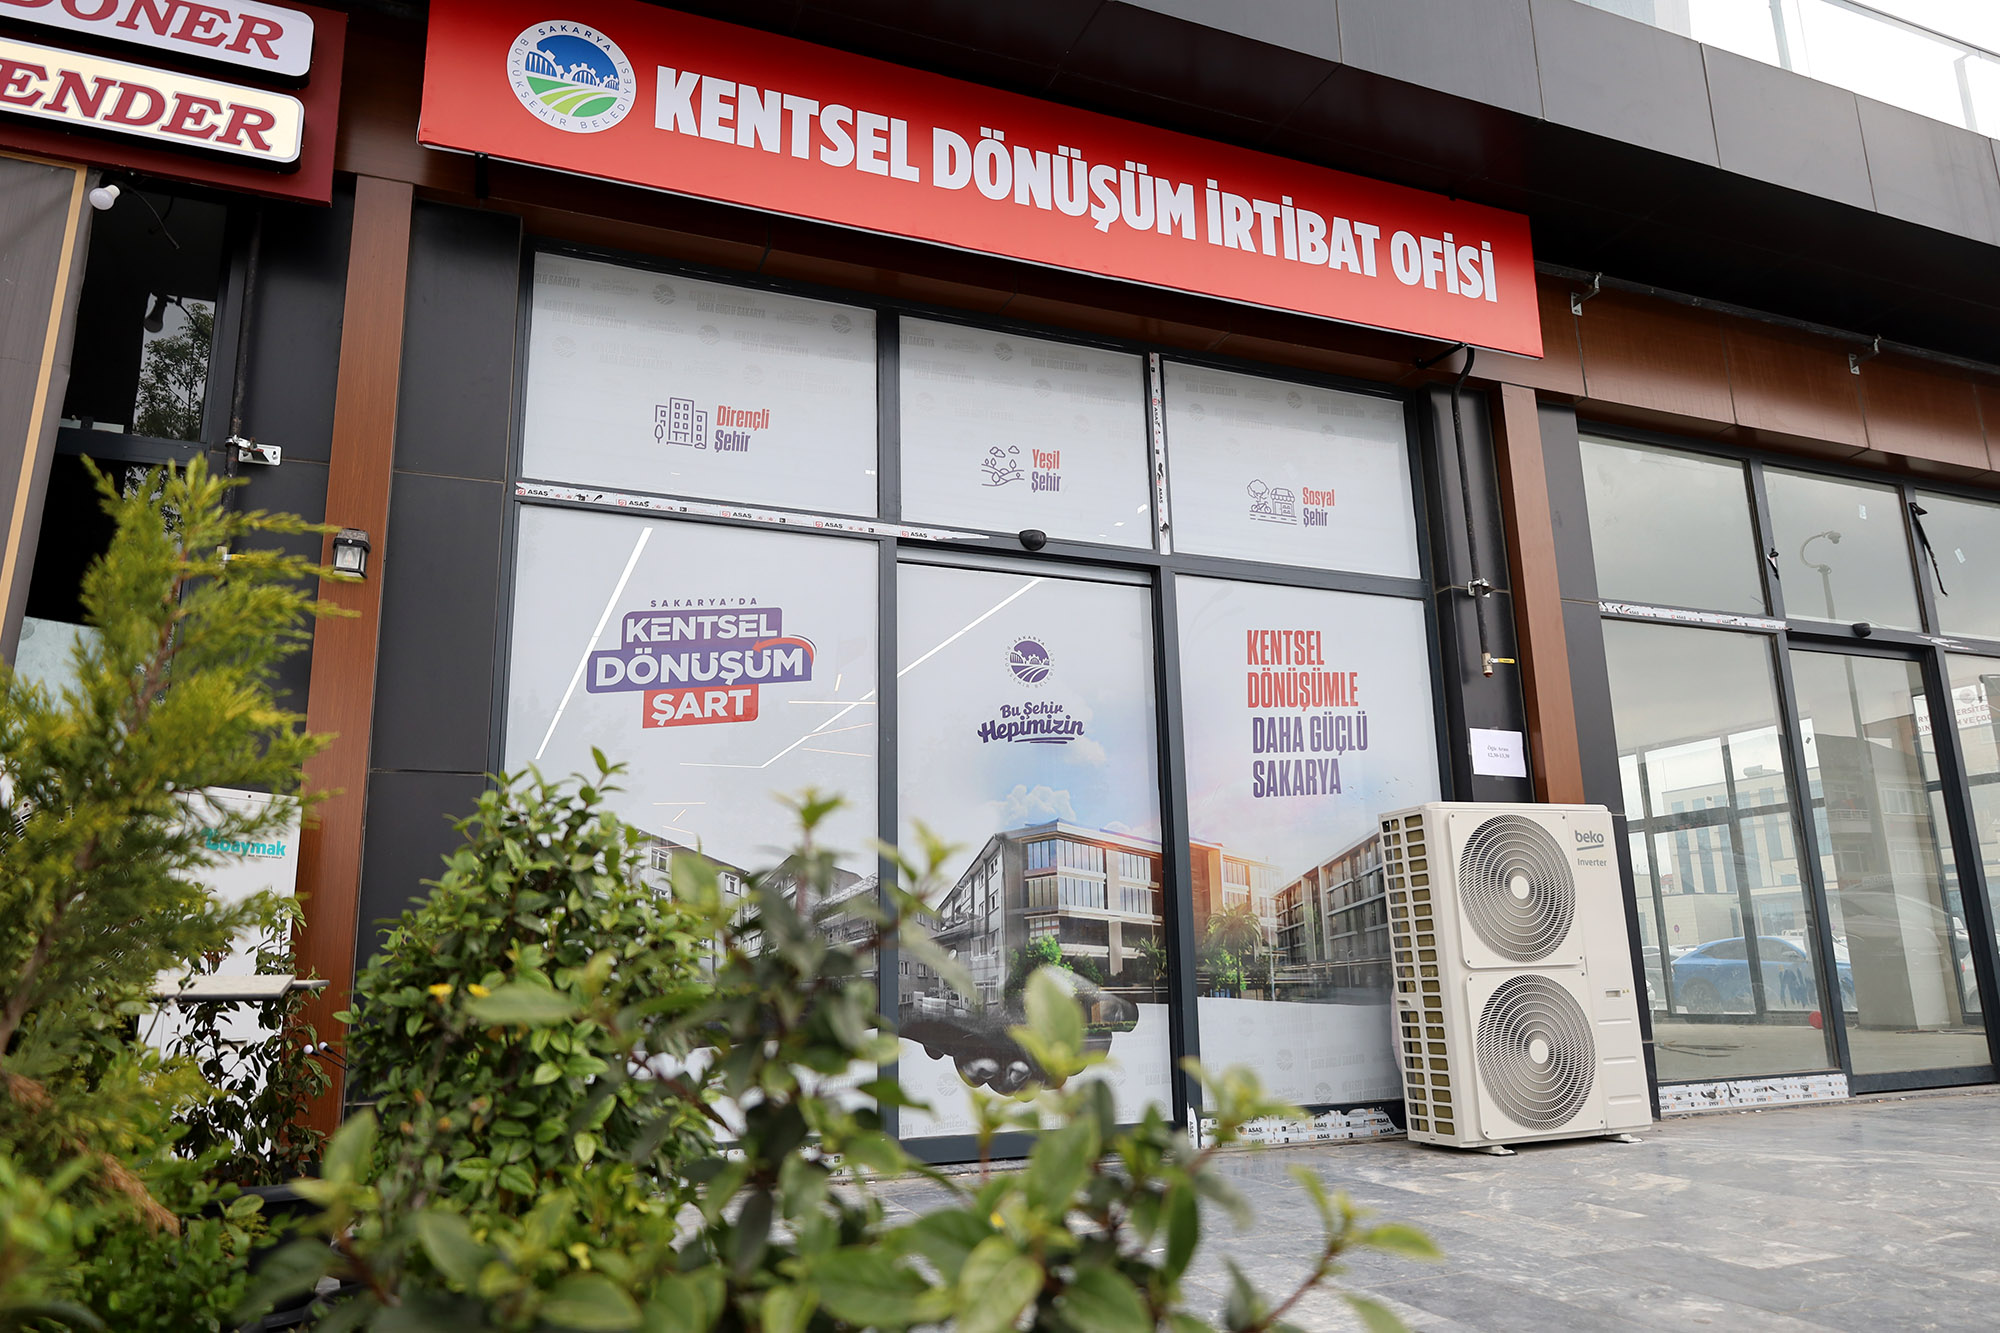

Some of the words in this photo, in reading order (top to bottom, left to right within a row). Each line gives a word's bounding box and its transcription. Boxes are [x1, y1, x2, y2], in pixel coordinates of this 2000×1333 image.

[0, 0, 284, 60] NER
[538, 24, 611, 52] SAKARYA
[654, 65, 920, 183] KENTSEL
[933, 126, 1197, 241] DÖNÜŞÜM
[1205, 178, 1381, 278] İRTİBAT
[1390, 231, 1498, 303] OFİSİ
[717, 405, 770, 431] Dirençli
[714, 430, 751, 453] Şehir
[1032, 449, 1060, 470] Yeşil
[527, 489, 549, 497] ASAS
[1031, 471, 1061, 492] Şehir
[1302, 487, 1335, 507] Sosyal
[732, 511, 752, 519] ASAS
[1303, 507, 1328, 527] Şehir
[650, 597, 758, 608] SAKARYA'DA
[626, 614, 778, 643] KENTSEL
[1247, 630, 1324, 665] KENTSEL
[1247, 667, 1358, 712] DÖNÜŞÜMLE
[651, 689, 751, 726] ŞART
[1000, 704, 1021, 718] Bu
[1023, 701, 1064, 719] Şehir
[977, 715, 1085, 744] Hepimizin
[1253, 717, 1304, 753] DAHA
[1310, 711, 1368, 756] GÜÇLÜ
[1253, 758, 1342, 798] SAKARYA
[1575, 830, 1604, 843] beko
[1577, 858, 1607, 867] Inverter
